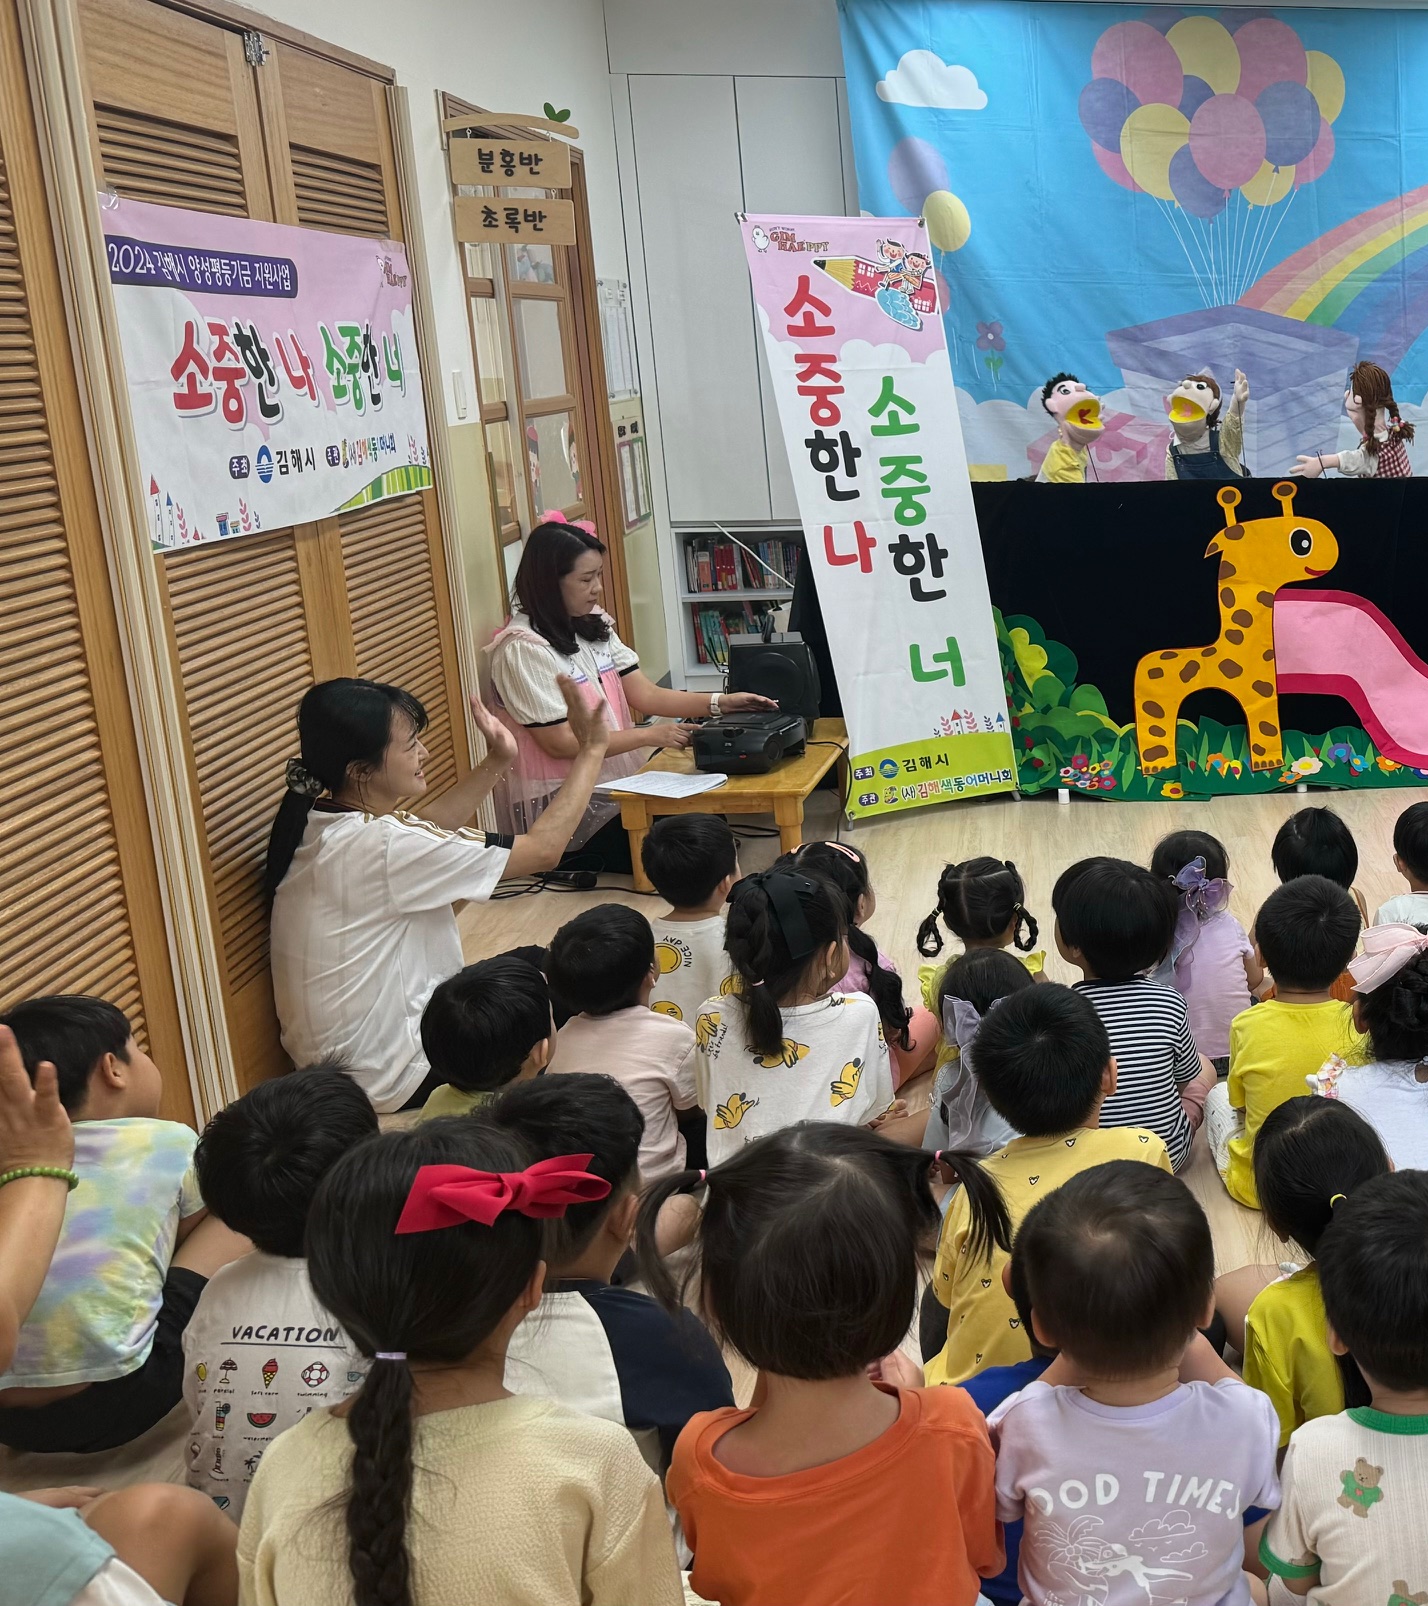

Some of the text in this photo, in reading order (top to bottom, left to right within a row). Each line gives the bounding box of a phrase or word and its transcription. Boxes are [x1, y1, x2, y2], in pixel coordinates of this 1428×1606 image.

[477, 148, 543, 177] 분홍반
[481, 205, 547, 233] 초록반
[108, 243, 291, 291] 2024 김해시 양성평등기금 지원사업
[170, 320, 404, 424] 소중한 나 소중한 너
[784, 275, 877, 573] 소중한 나
[231, 446, 316, 475] 주최 김해시
[326, 447, 339, 464] 주관
[868, 375, 966, 687] 소중한 너
[855, 753, 950, 779] 주최 김해시
[861, 793, 876, 805] 주관
[663, 935, 692, 968] NICE DAY
[232, 1325, 340, 1343] VACATION
